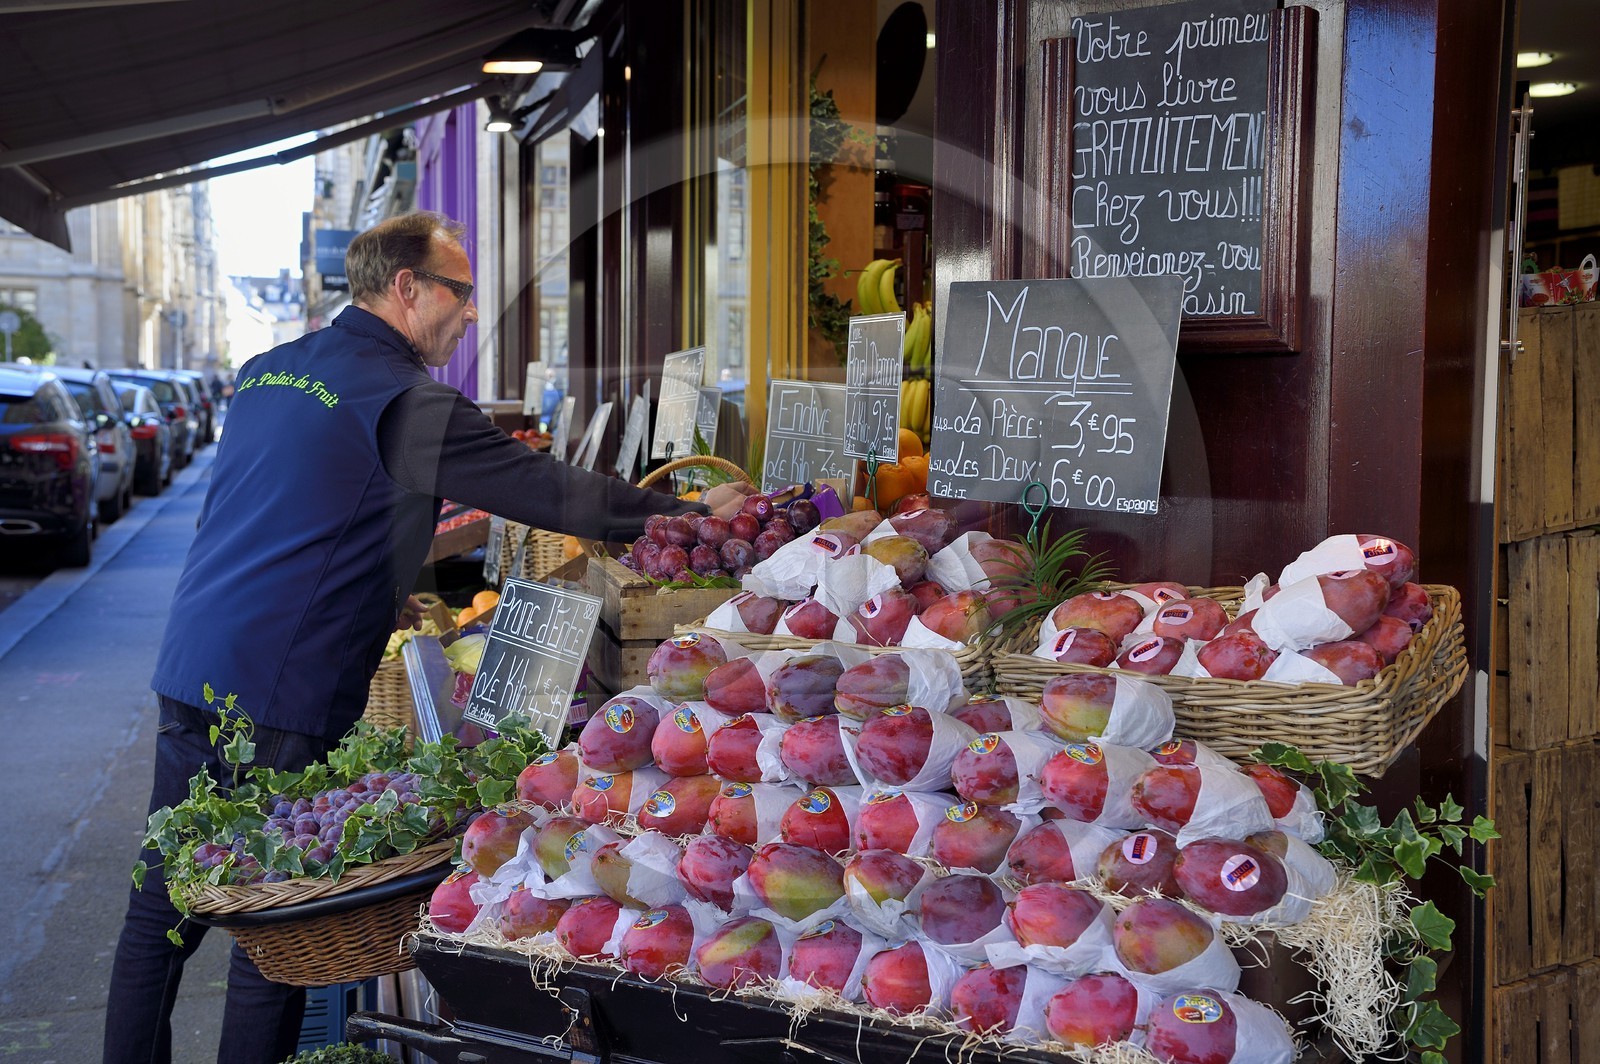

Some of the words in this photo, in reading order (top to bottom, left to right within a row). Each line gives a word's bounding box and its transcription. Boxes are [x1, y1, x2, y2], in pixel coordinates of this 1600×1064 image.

[1071, 16, 1151, 64] Votre
[1165, 13, 1269, 76] primeu
[1073, 82, 1147, 117] vous
[1156, 62, 1237, 108] livre
[1071, 181, 1146, 244] Chez
[1157, 176, 1263, 222] vous!!!
[1182, 285, 1256, 316] asin
[237, 377, 256, 392] Le
[257, 371, 295, 386] Palais
[293, 374, 310, 389] du
[305, 381, 339, 408] Fruit
